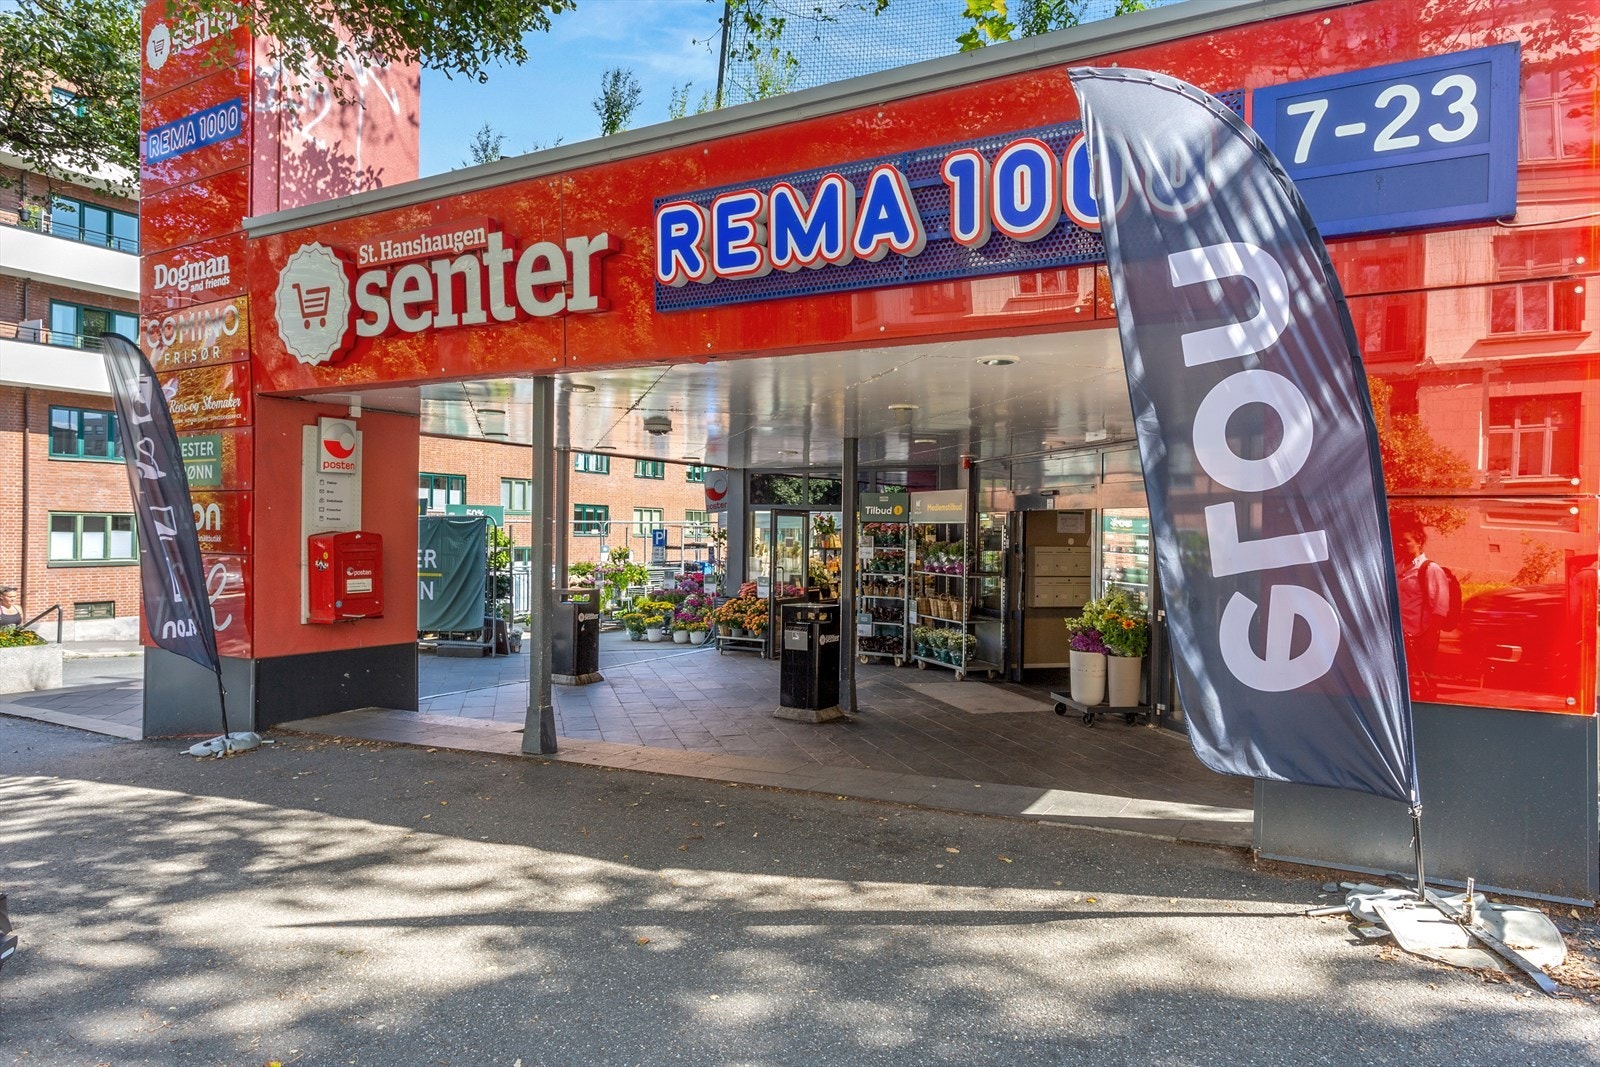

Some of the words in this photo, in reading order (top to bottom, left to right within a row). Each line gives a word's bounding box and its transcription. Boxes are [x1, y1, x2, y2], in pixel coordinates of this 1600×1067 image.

[1287, 74, 1478, 164] 7-23
[150, 121, 196, 158] REMA
[199, 106, 239, 141] 1000
[655, 163, 924, 287] REMA
[359, 244, 378, 264] St.
[380, 227, 486, 261] Hanshaugen
[154, 255, 230, 291] Dogman
[190, 281, 204, 293] and
[205, 275, 230, 289] friends
[355, 231, 608, 337] senter
[146, 304, 239, 348] COMINO
[165, 346, 220, 365] FRISØR
[169, 399, 187, 413] Rens
[189, 401, 200, 416] og
[202, 393, 241, 411] Skomaker
[180, 441, 214, 457] ESTER
[184, 465, 213, 480] ØNN
[323, 461, 355, 470] posten
[193, 503, 220, 530] on
[865, 506, 893, 515] Tilbud
[655, 531, 664, 545] P
